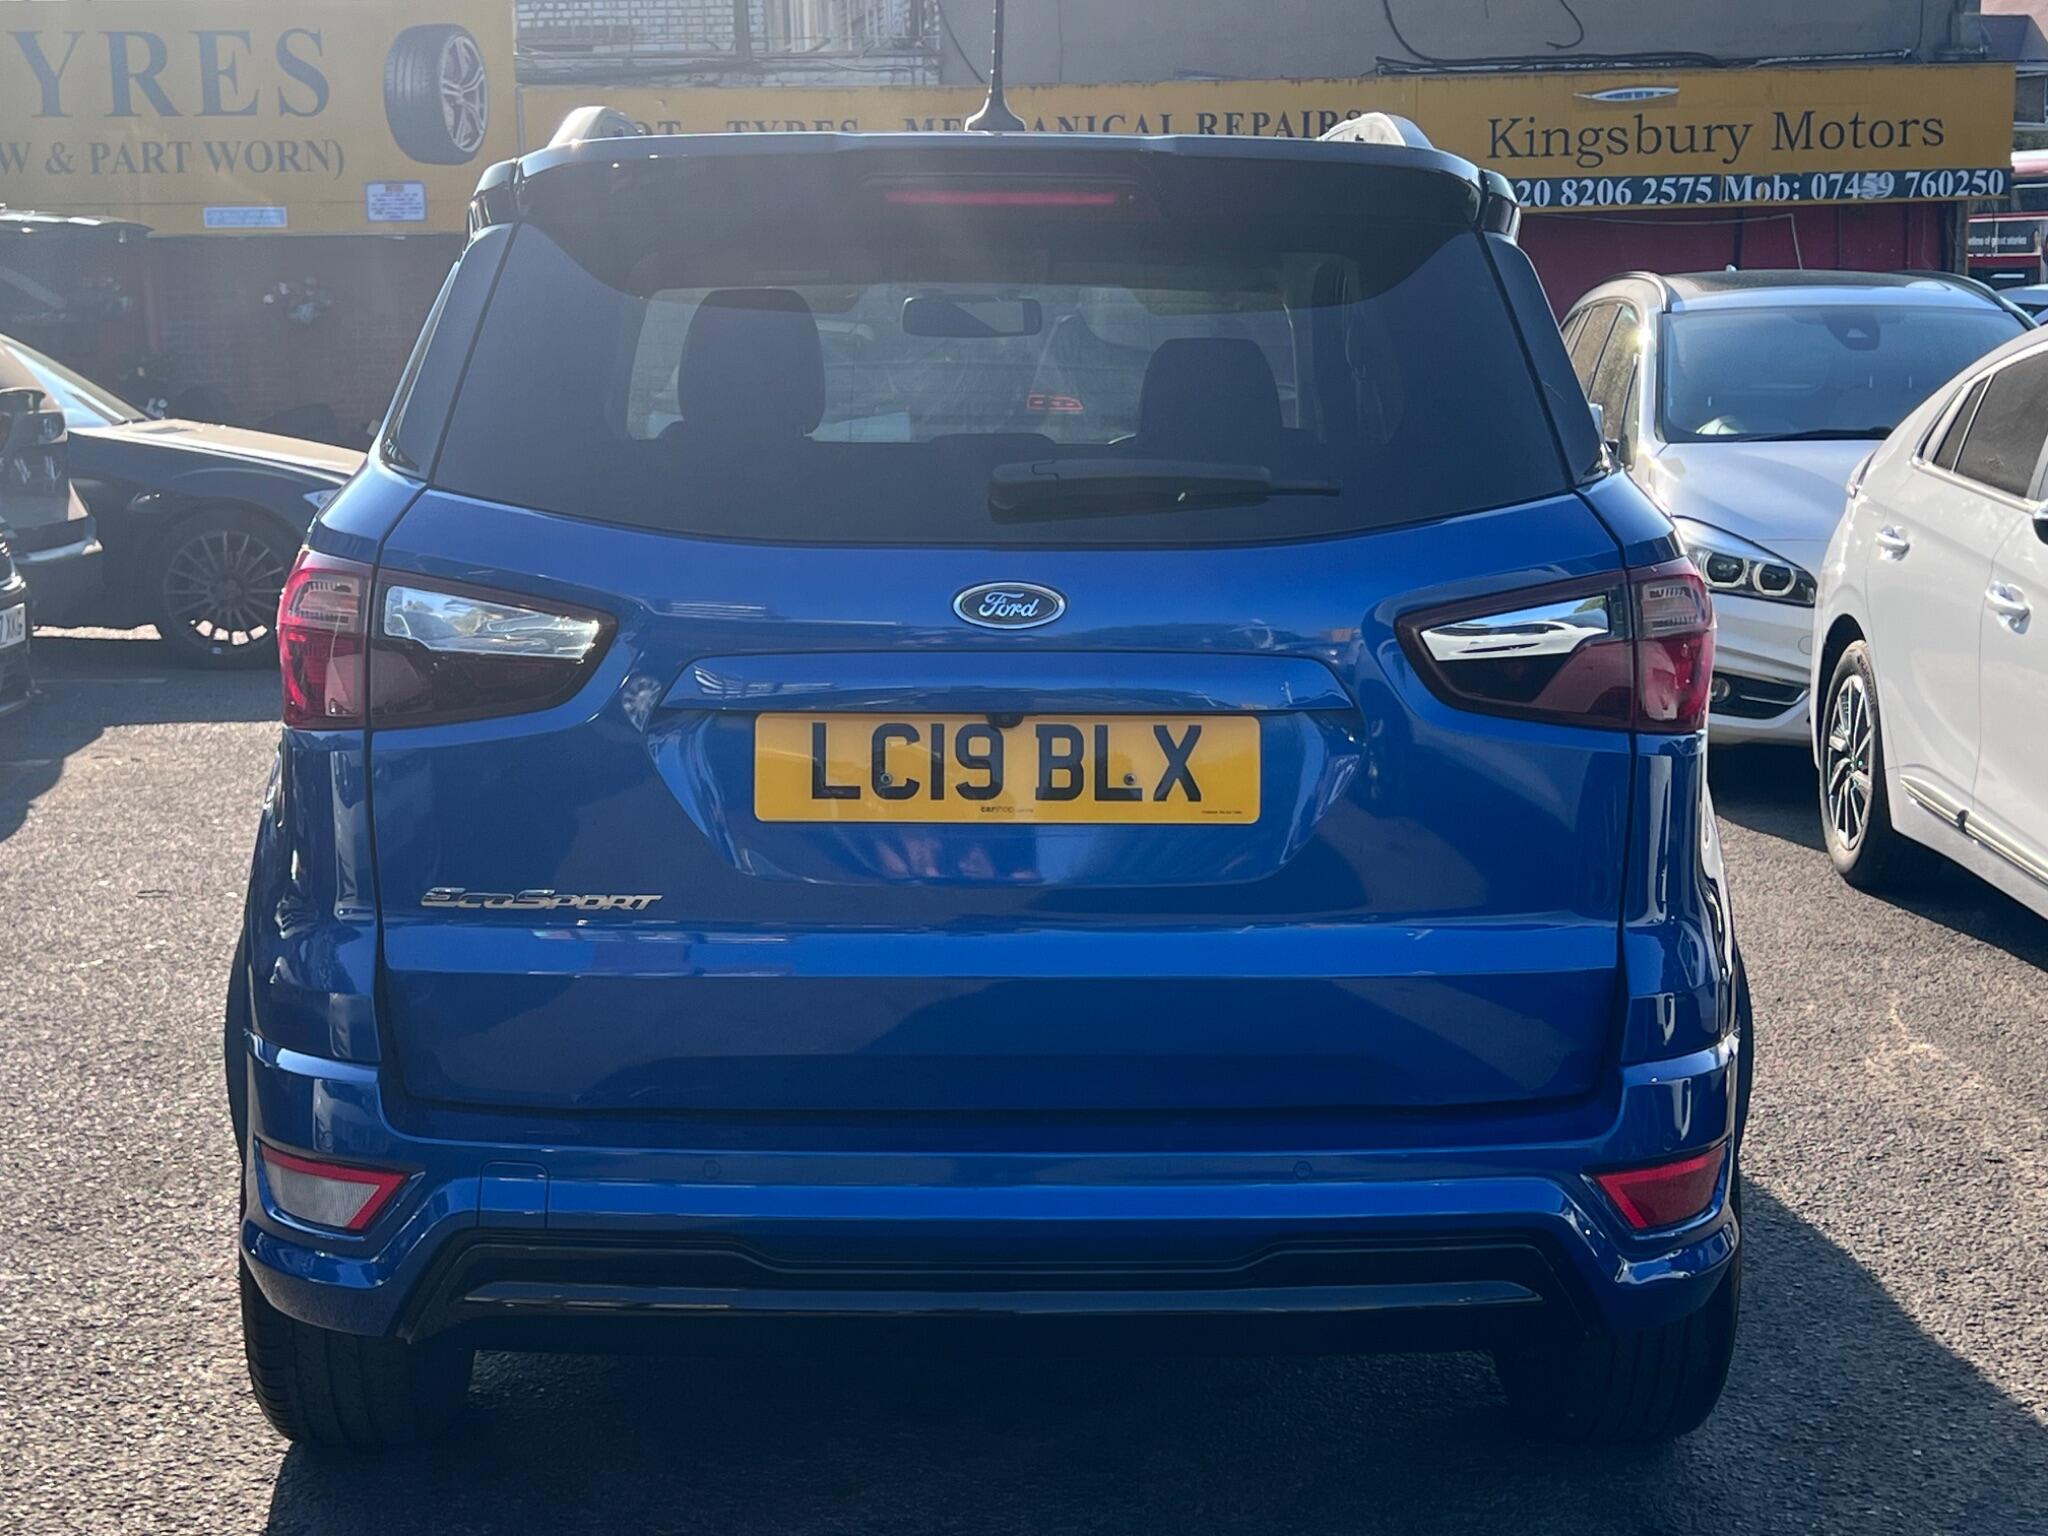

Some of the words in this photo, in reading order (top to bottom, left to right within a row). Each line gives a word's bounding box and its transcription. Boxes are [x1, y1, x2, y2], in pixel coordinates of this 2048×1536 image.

[8, 27, 330, 119] YRES
[45, 141, 76, 175] &
[88, 140, 192, 175] PART
[203, 138, 345, 180] WORN)
[1487, 113, 1753, 168] Kingsbury
[1771, 110, 1945, 151] Motors
[1561, 177, 1633, 206] 8206
[1642, 176, 1713, 205] 2575
[1724, 174, 1800, 201] Mob:
[1905, 169, 2005, 198] 760250
[978, 591, 1040, 617] Ford
[811, 721, 1005, 801] LC19
[1035, 723, 1203, 803] BLX
